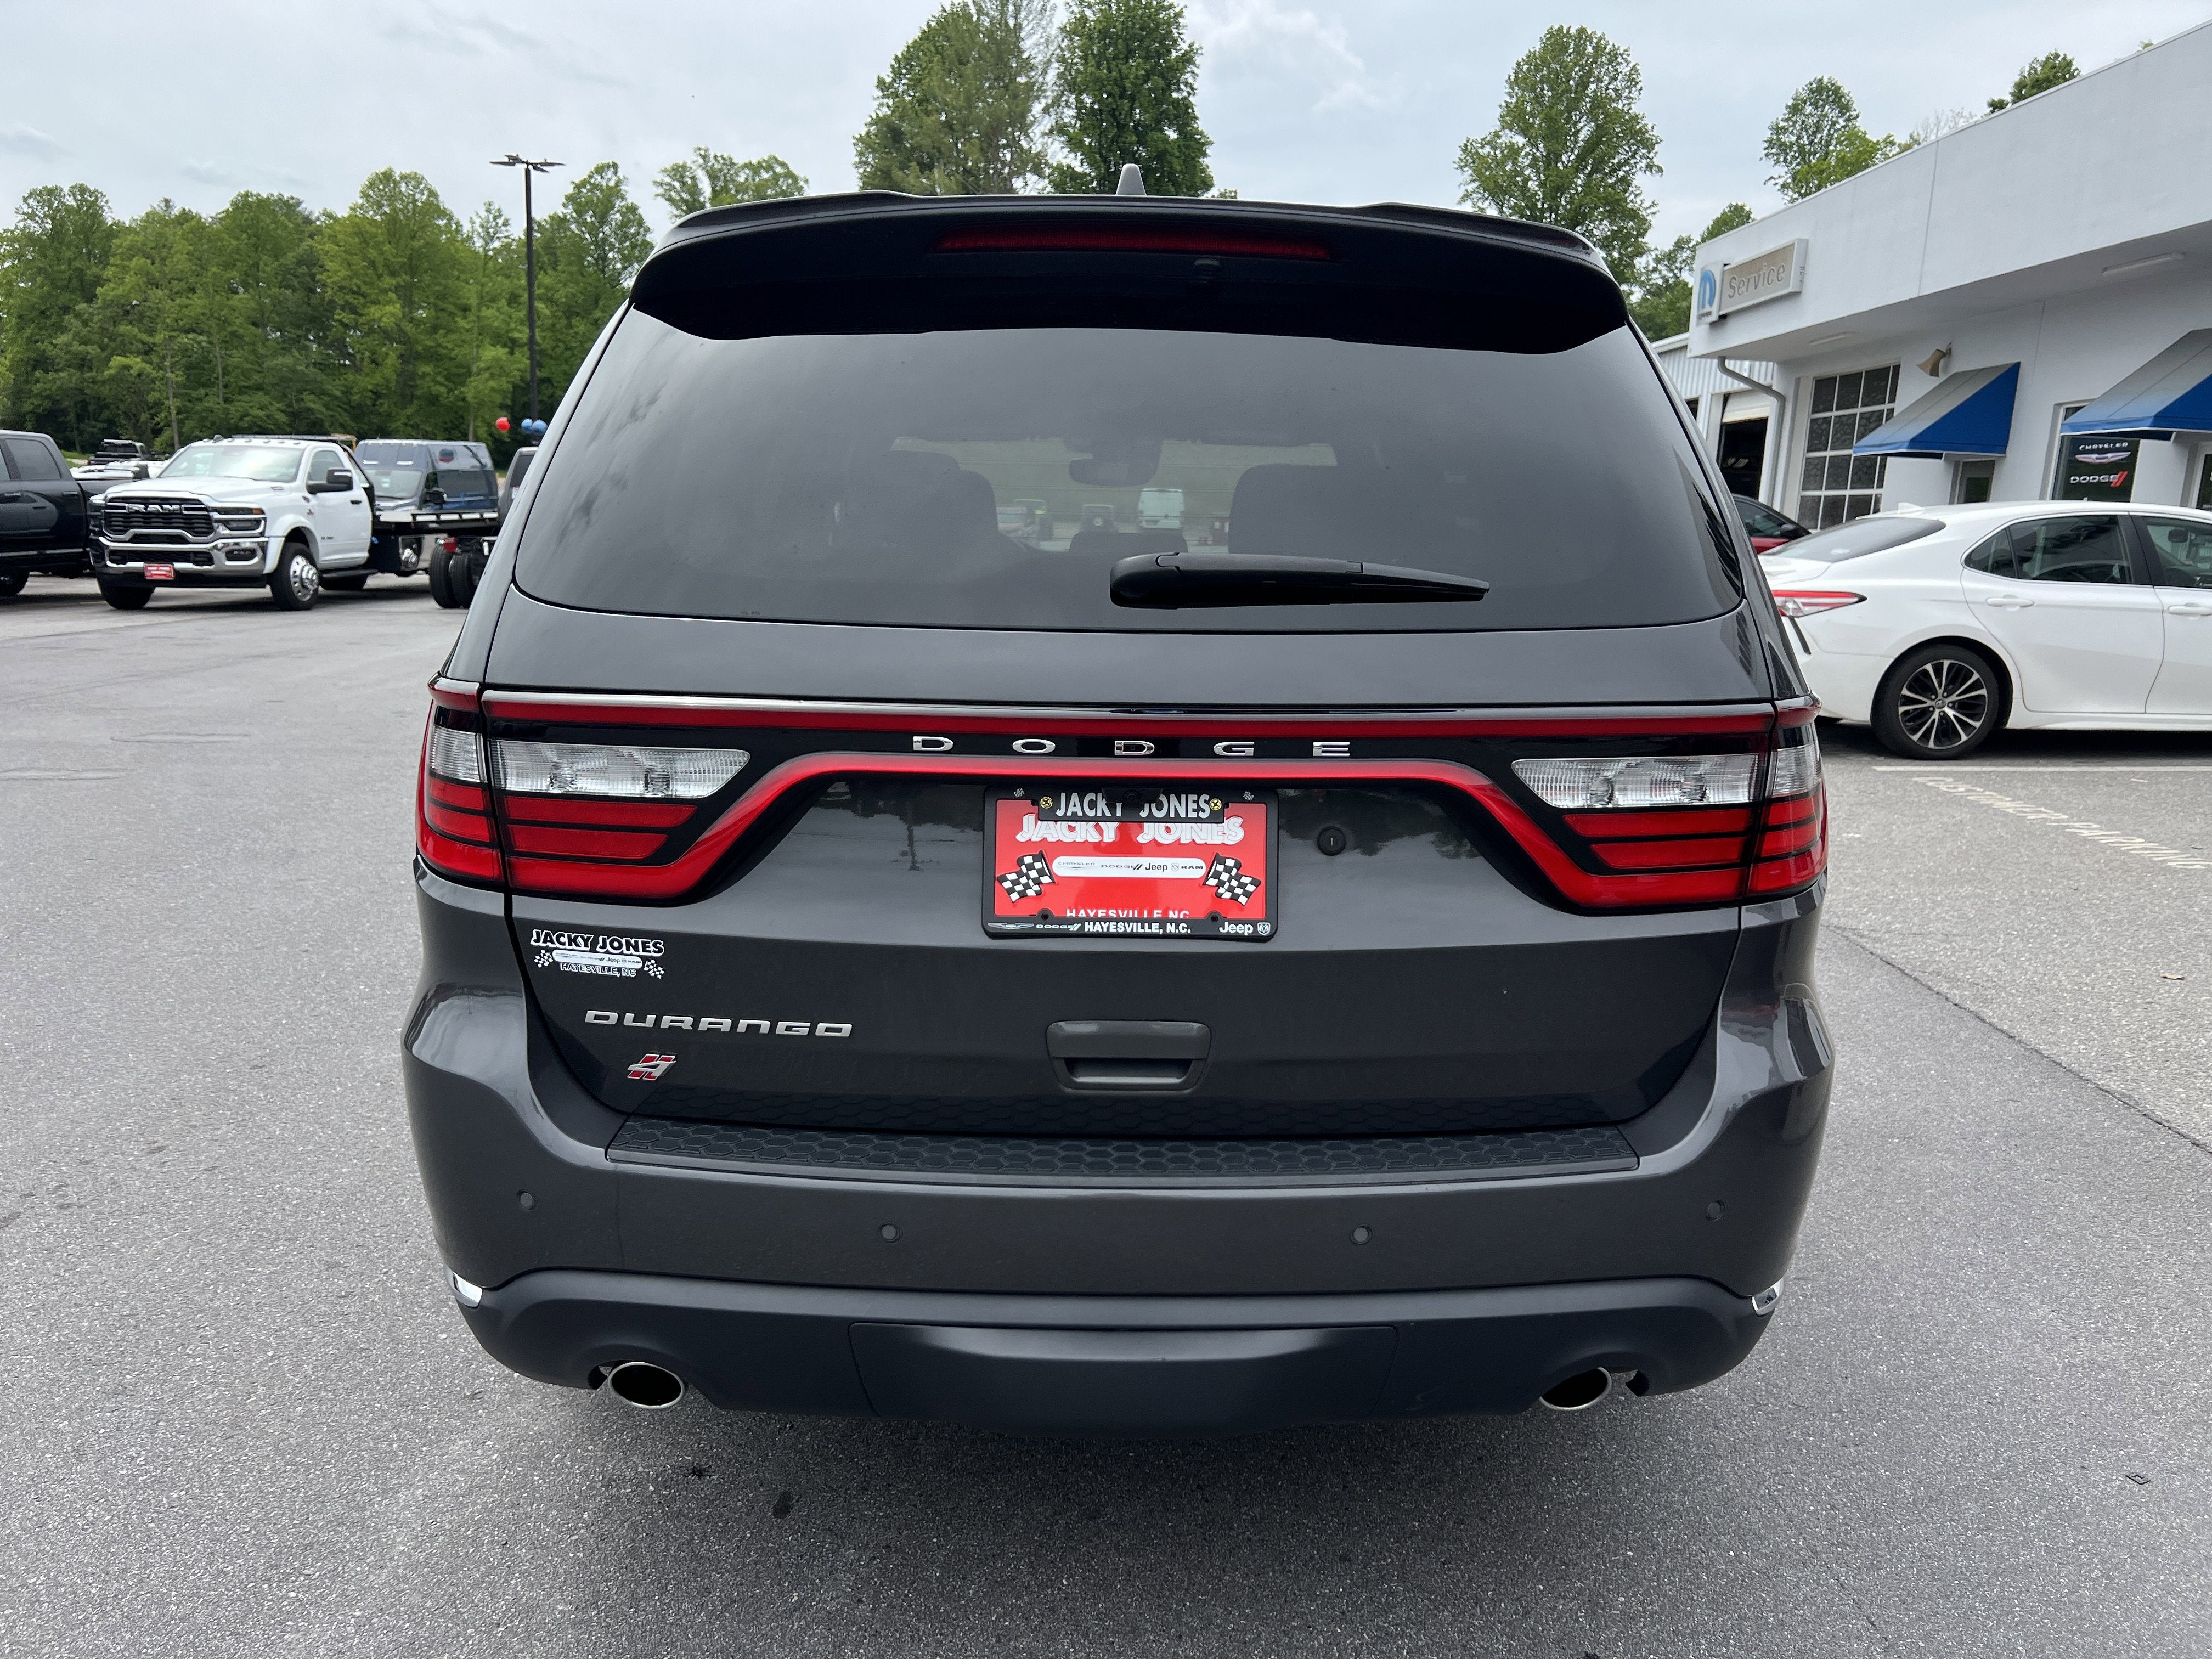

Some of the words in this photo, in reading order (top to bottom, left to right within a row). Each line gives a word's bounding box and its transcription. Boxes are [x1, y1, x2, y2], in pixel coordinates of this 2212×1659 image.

[1728, 262, 1785, 298] Service
[2070, 474, 2120, 484] DODGE
[127, 504, 180, 513] RAM
[912, 735, 1351, 757] DODGE
[1139, 793, 1210, 819] JONES
[1015, 813, 1121, 843] JACKY
[1136, 816, 1245, 845] JONES
[1144, 862, 1169, 872] Jeep
[1084, 921, 1163, 934] HAYESVILLE,
[1166, 922, 1192, 933] N.C.
[1219, 922, 1254, 935] Jeep
[530, 929, 594, 951] JACKY
[596, 935, 665, 957] JONES
[560, 962, 620, 977] HAYESVILLE,
[622, 968, 637, 977] NC
[585, 1010, 853, 1037] DURANGO
